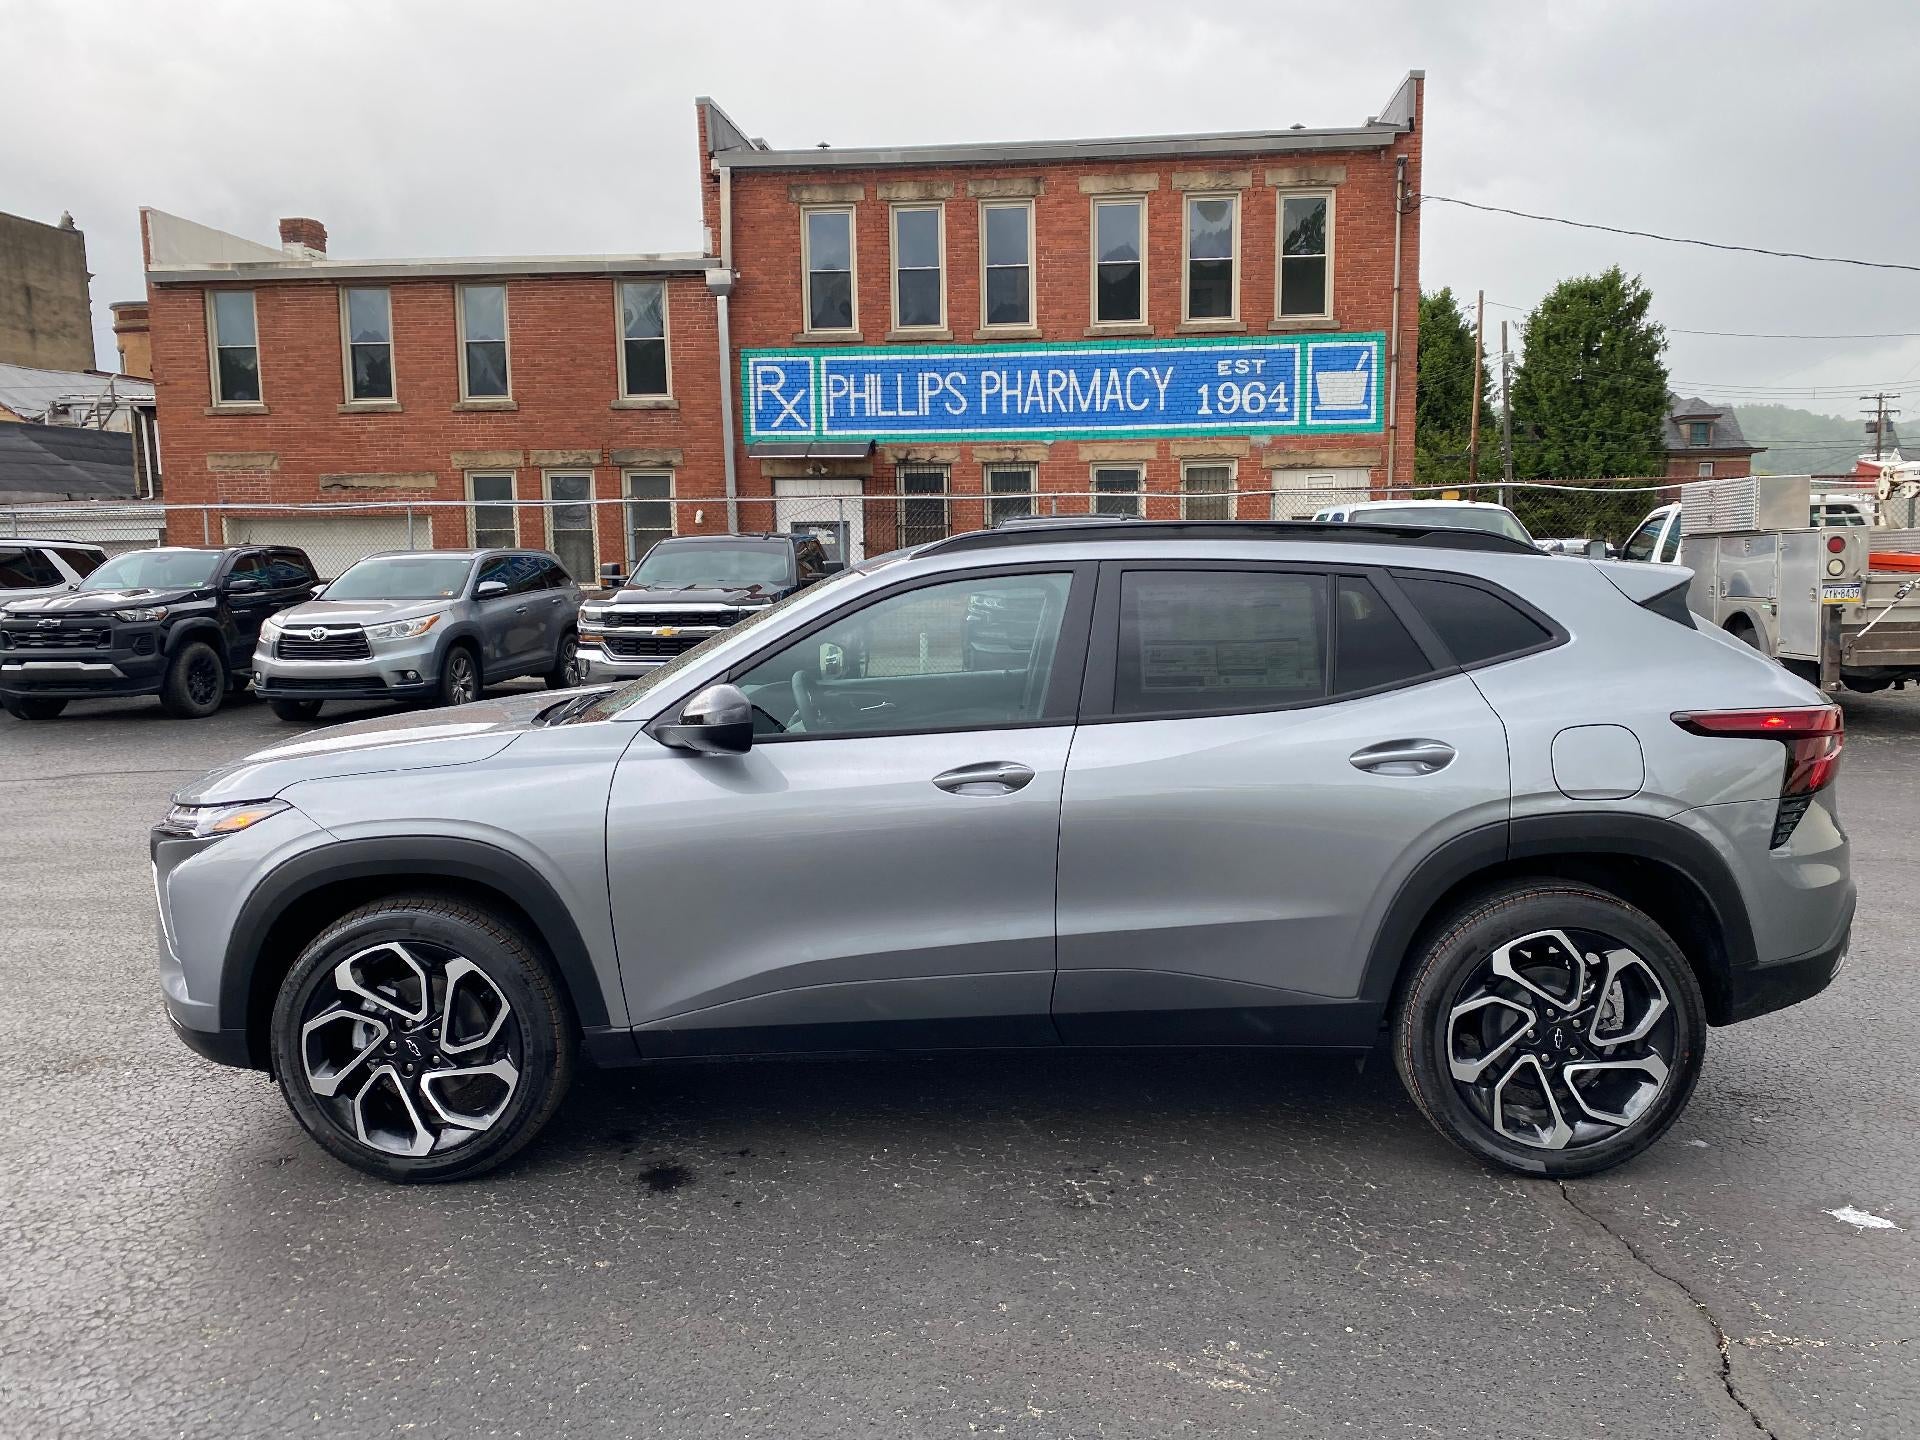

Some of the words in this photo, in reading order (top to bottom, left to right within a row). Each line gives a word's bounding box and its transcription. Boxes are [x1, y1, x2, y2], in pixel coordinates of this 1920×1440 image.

[1217, 359, 1267, 376] EST
[828, 370, 968, 417] PHILLIPS
[980, 366, 1174, 415] PHARMACY
[1197, 381, 1289, 415] 1964
